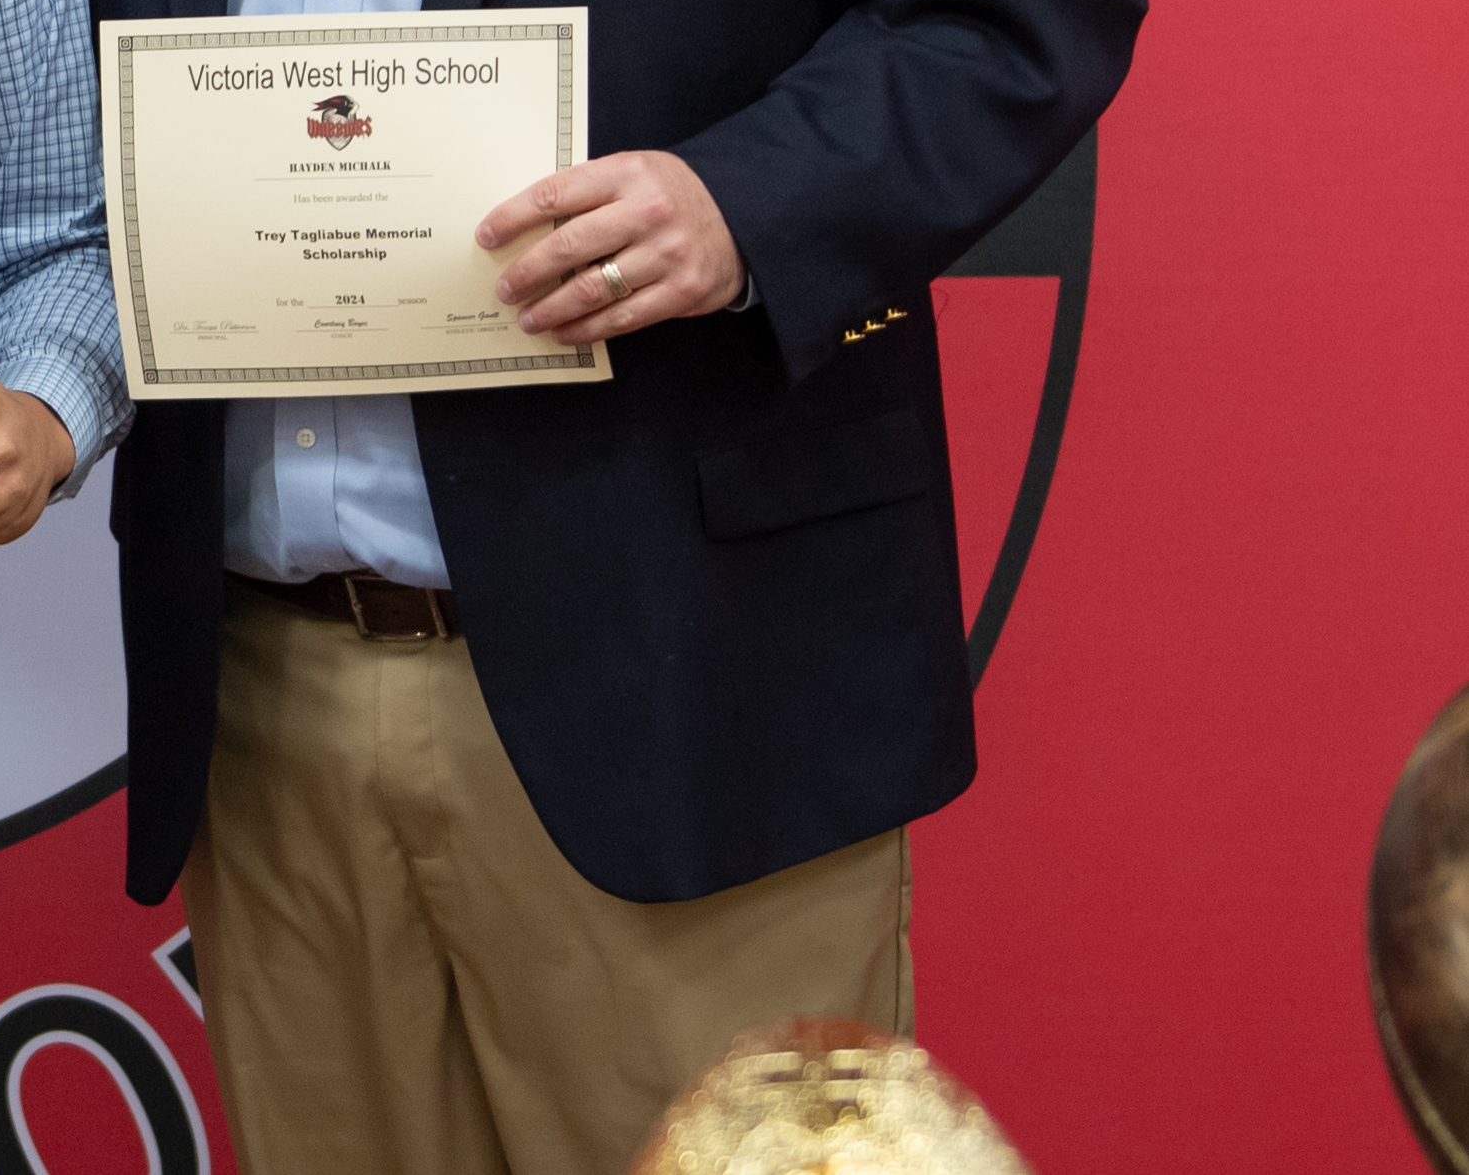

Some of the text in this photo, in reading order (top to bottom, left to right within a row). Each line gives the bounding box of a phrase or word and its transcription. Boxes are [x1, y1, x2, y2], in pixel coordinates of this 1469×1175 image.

[187, 57, 500, 93] Victoria West High School
[289, 161, 391, 173] HAYDEN MICHALK
[293, 192, 389, 204] Has been awarded the
[255, 227, 432, 244] Trey Tagliabue Memorial
[302, 248, 387, 261] Scholarship
[276, 294, 428, 307] for the 2024 season
